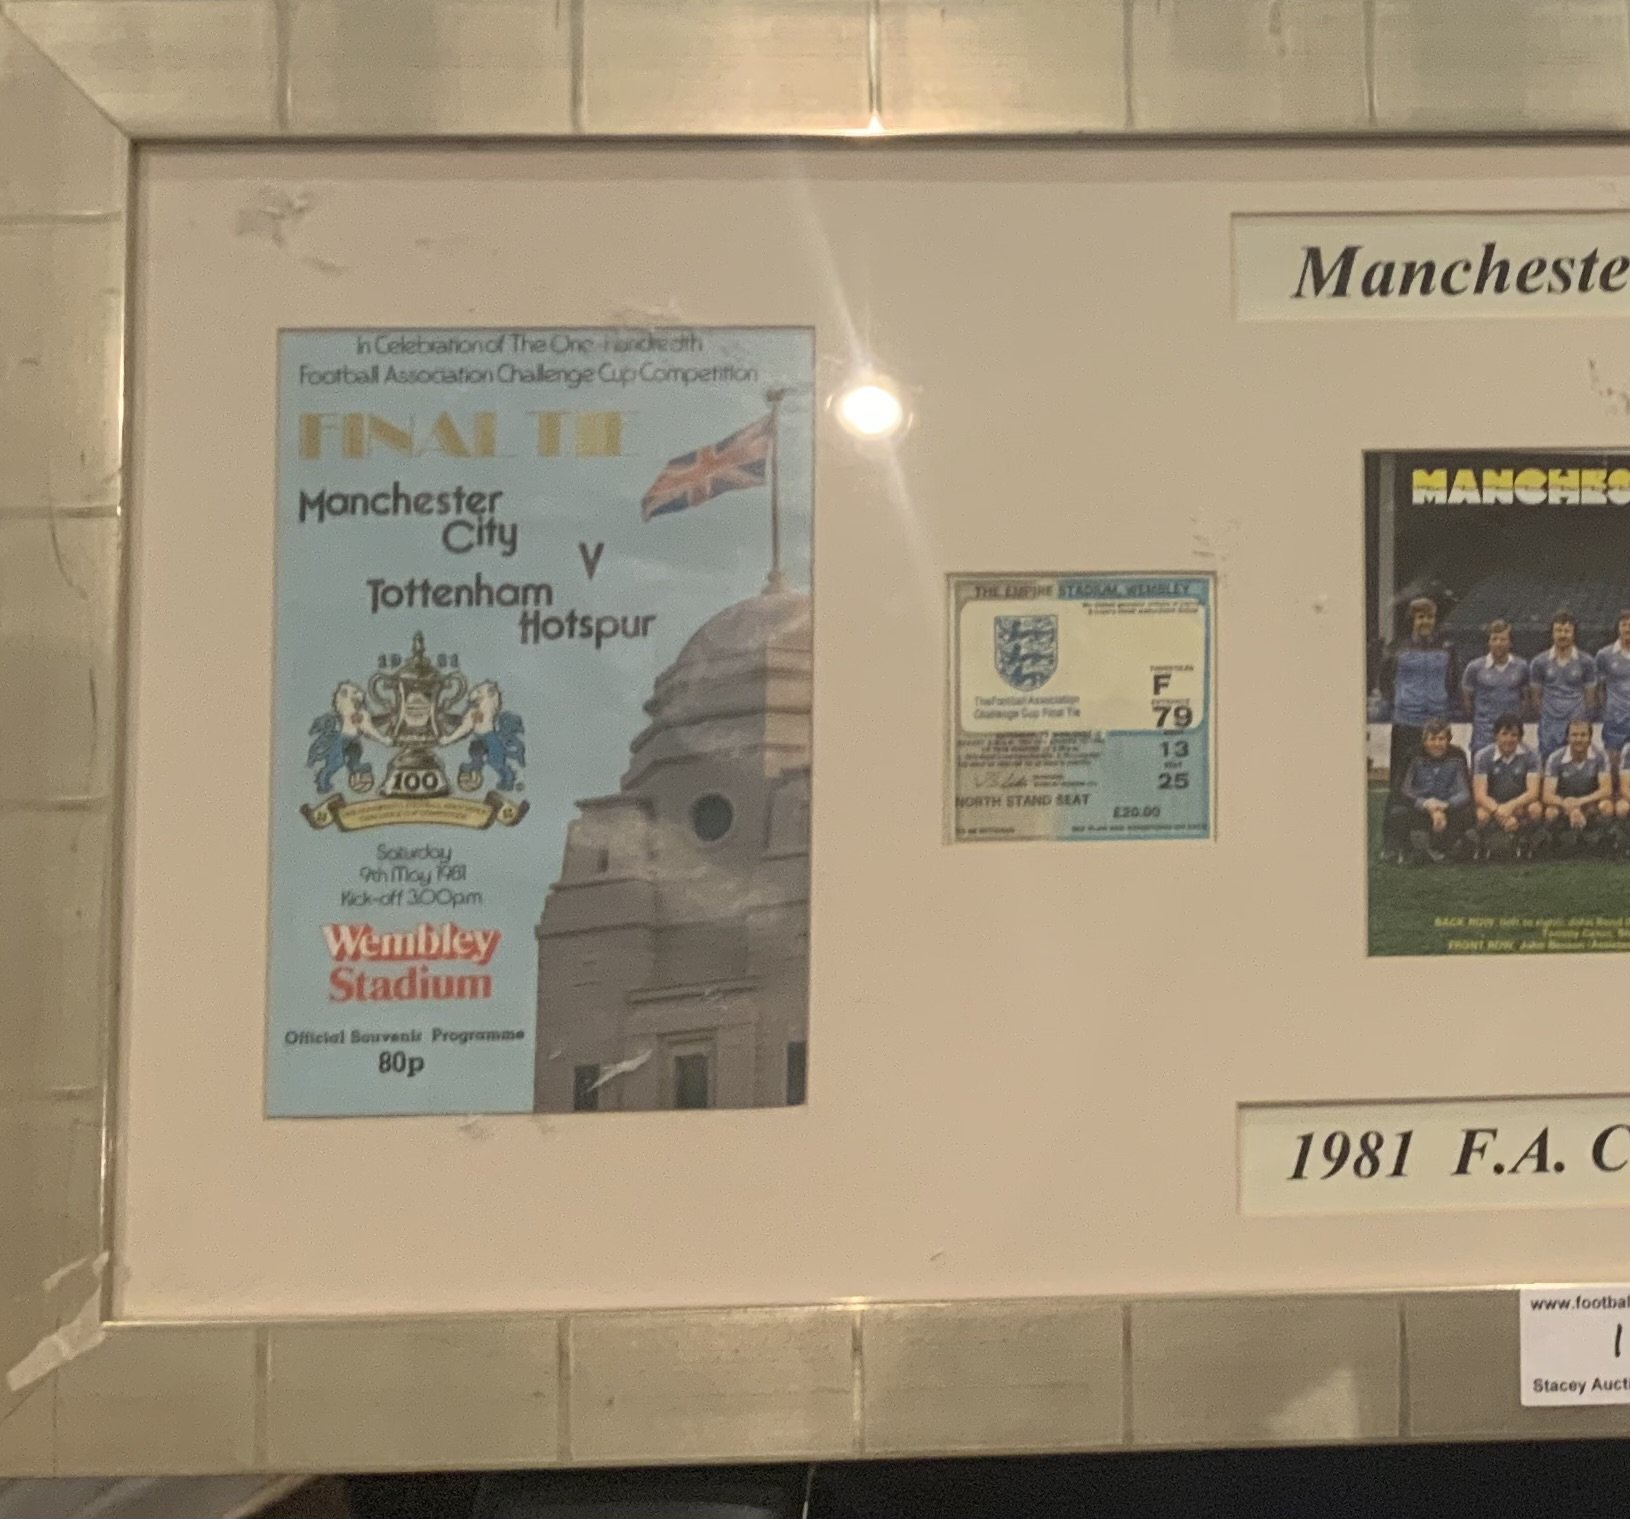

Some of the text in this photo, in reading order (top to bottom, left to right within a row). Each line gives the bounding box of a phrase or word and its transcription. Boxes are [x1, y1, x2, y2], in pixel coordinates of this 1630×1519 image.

[356, 336, 371, 355] In
[374, 334, 483, 355] Celebration
[484, 333, 505, 354] of
[511, 333, 547, 353] The
[550, 333, 594, 353] One
[299, 362, 759, 389] Football Association Challenge Cup Competition
[300, 410, 518, 460] FINAL
[299, 481, 504, 524] Manchester
[441, 516, 518, 558] City
[366, 572, 554, 615] Tottenham
[517, 608, 658, 651] Hotspur
[1152, 673, 1173, 696] F
[1152, 705, 1194, 729] 79
[1159, 740, 1191, 759] 13
[392, 770, 439, 791] 100
[1157, 772, 1191, 791] 25
[955, 792, 1091, 809] NORTH STAND SEAT
[376, 843, 454, 865] Saturday
[359, 864, 468, 887] 9th May 1981
[340, 889, 404, 908] Kick-off
[321, 920, 503, 967] Wembley
[327, 963, 493, 1005] Stadium
[284, 1026, 526, 1047] Official Souvenir Programme
[378, 1050, 426, 1078] 80p
[1286, 1129, 1415, 1181] 1981
[1450, 1126, 1567, 1178] F.A.
[1533, 1377, 1587, 1396] Stacey
